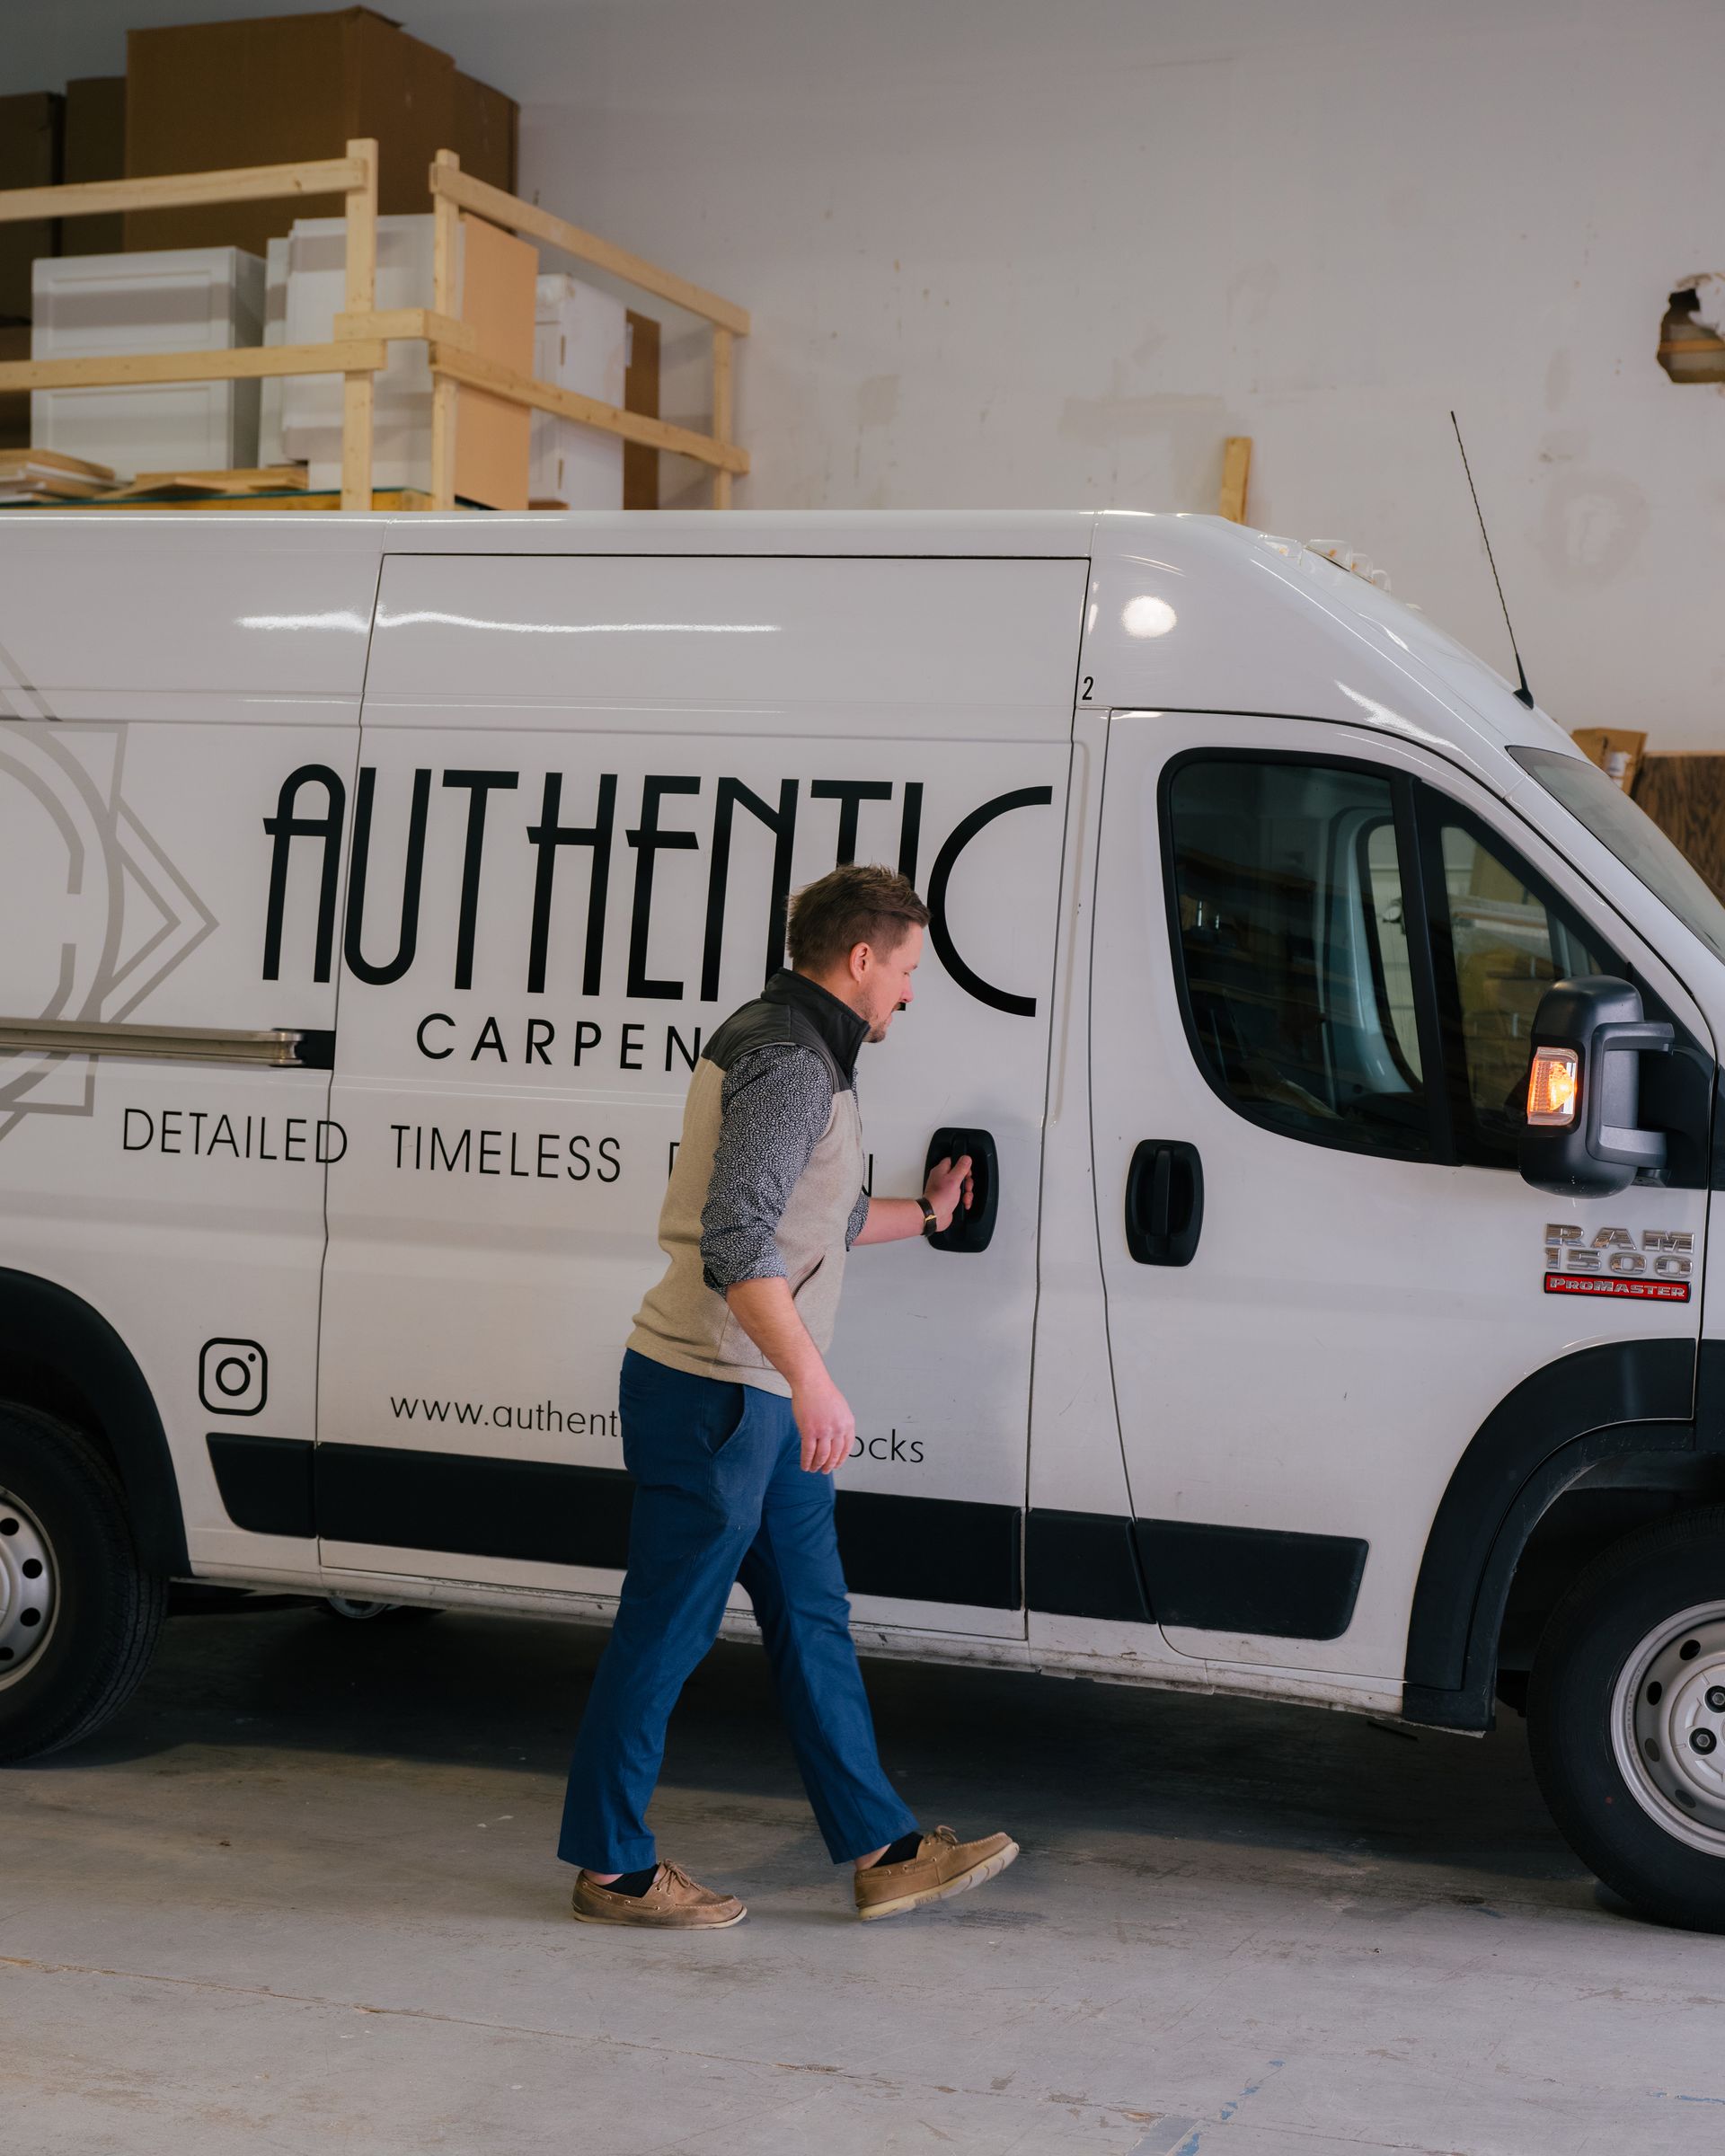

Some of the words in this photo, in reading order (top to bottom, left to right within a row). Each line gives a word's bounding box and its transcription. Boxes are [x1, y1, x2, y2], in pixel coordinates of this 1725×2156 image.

[1082, 676, 1094, 701] 2
[261, 764, 1053, 1018] AUTHENTIC
[416, 1012, 702, 1074] CARPEN
[122, 1108, 348, 1164] DETAILED
[390, 1124, 621, 1183] TIMELESS
[1544, 1247, 1694, 1278] 1500
[1545, 1223, 1695, 1255] RAM
